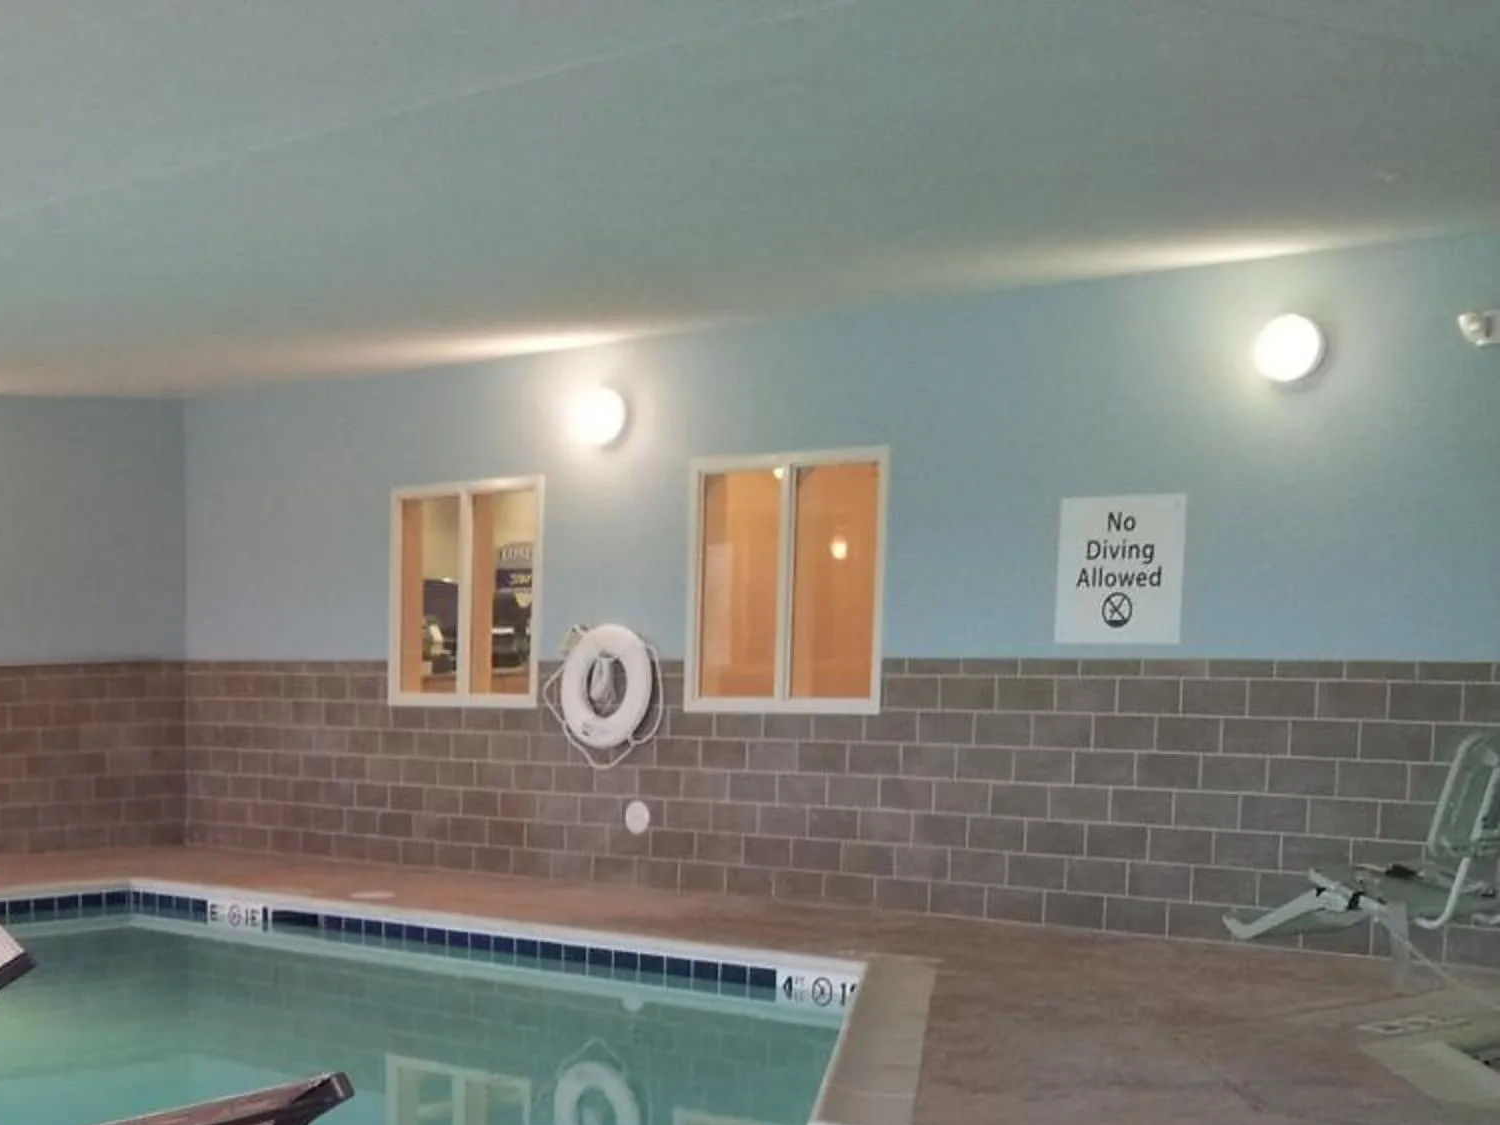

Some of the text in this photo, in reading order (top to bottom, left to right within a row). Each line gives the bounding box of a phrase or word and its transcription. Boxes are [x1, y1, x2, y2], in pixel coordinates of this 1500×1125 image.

[1107, 511, 1136, 532] No
[1086, 539, 1155, 565] Diving
[1075, 565, 1162, 588] Allowed
